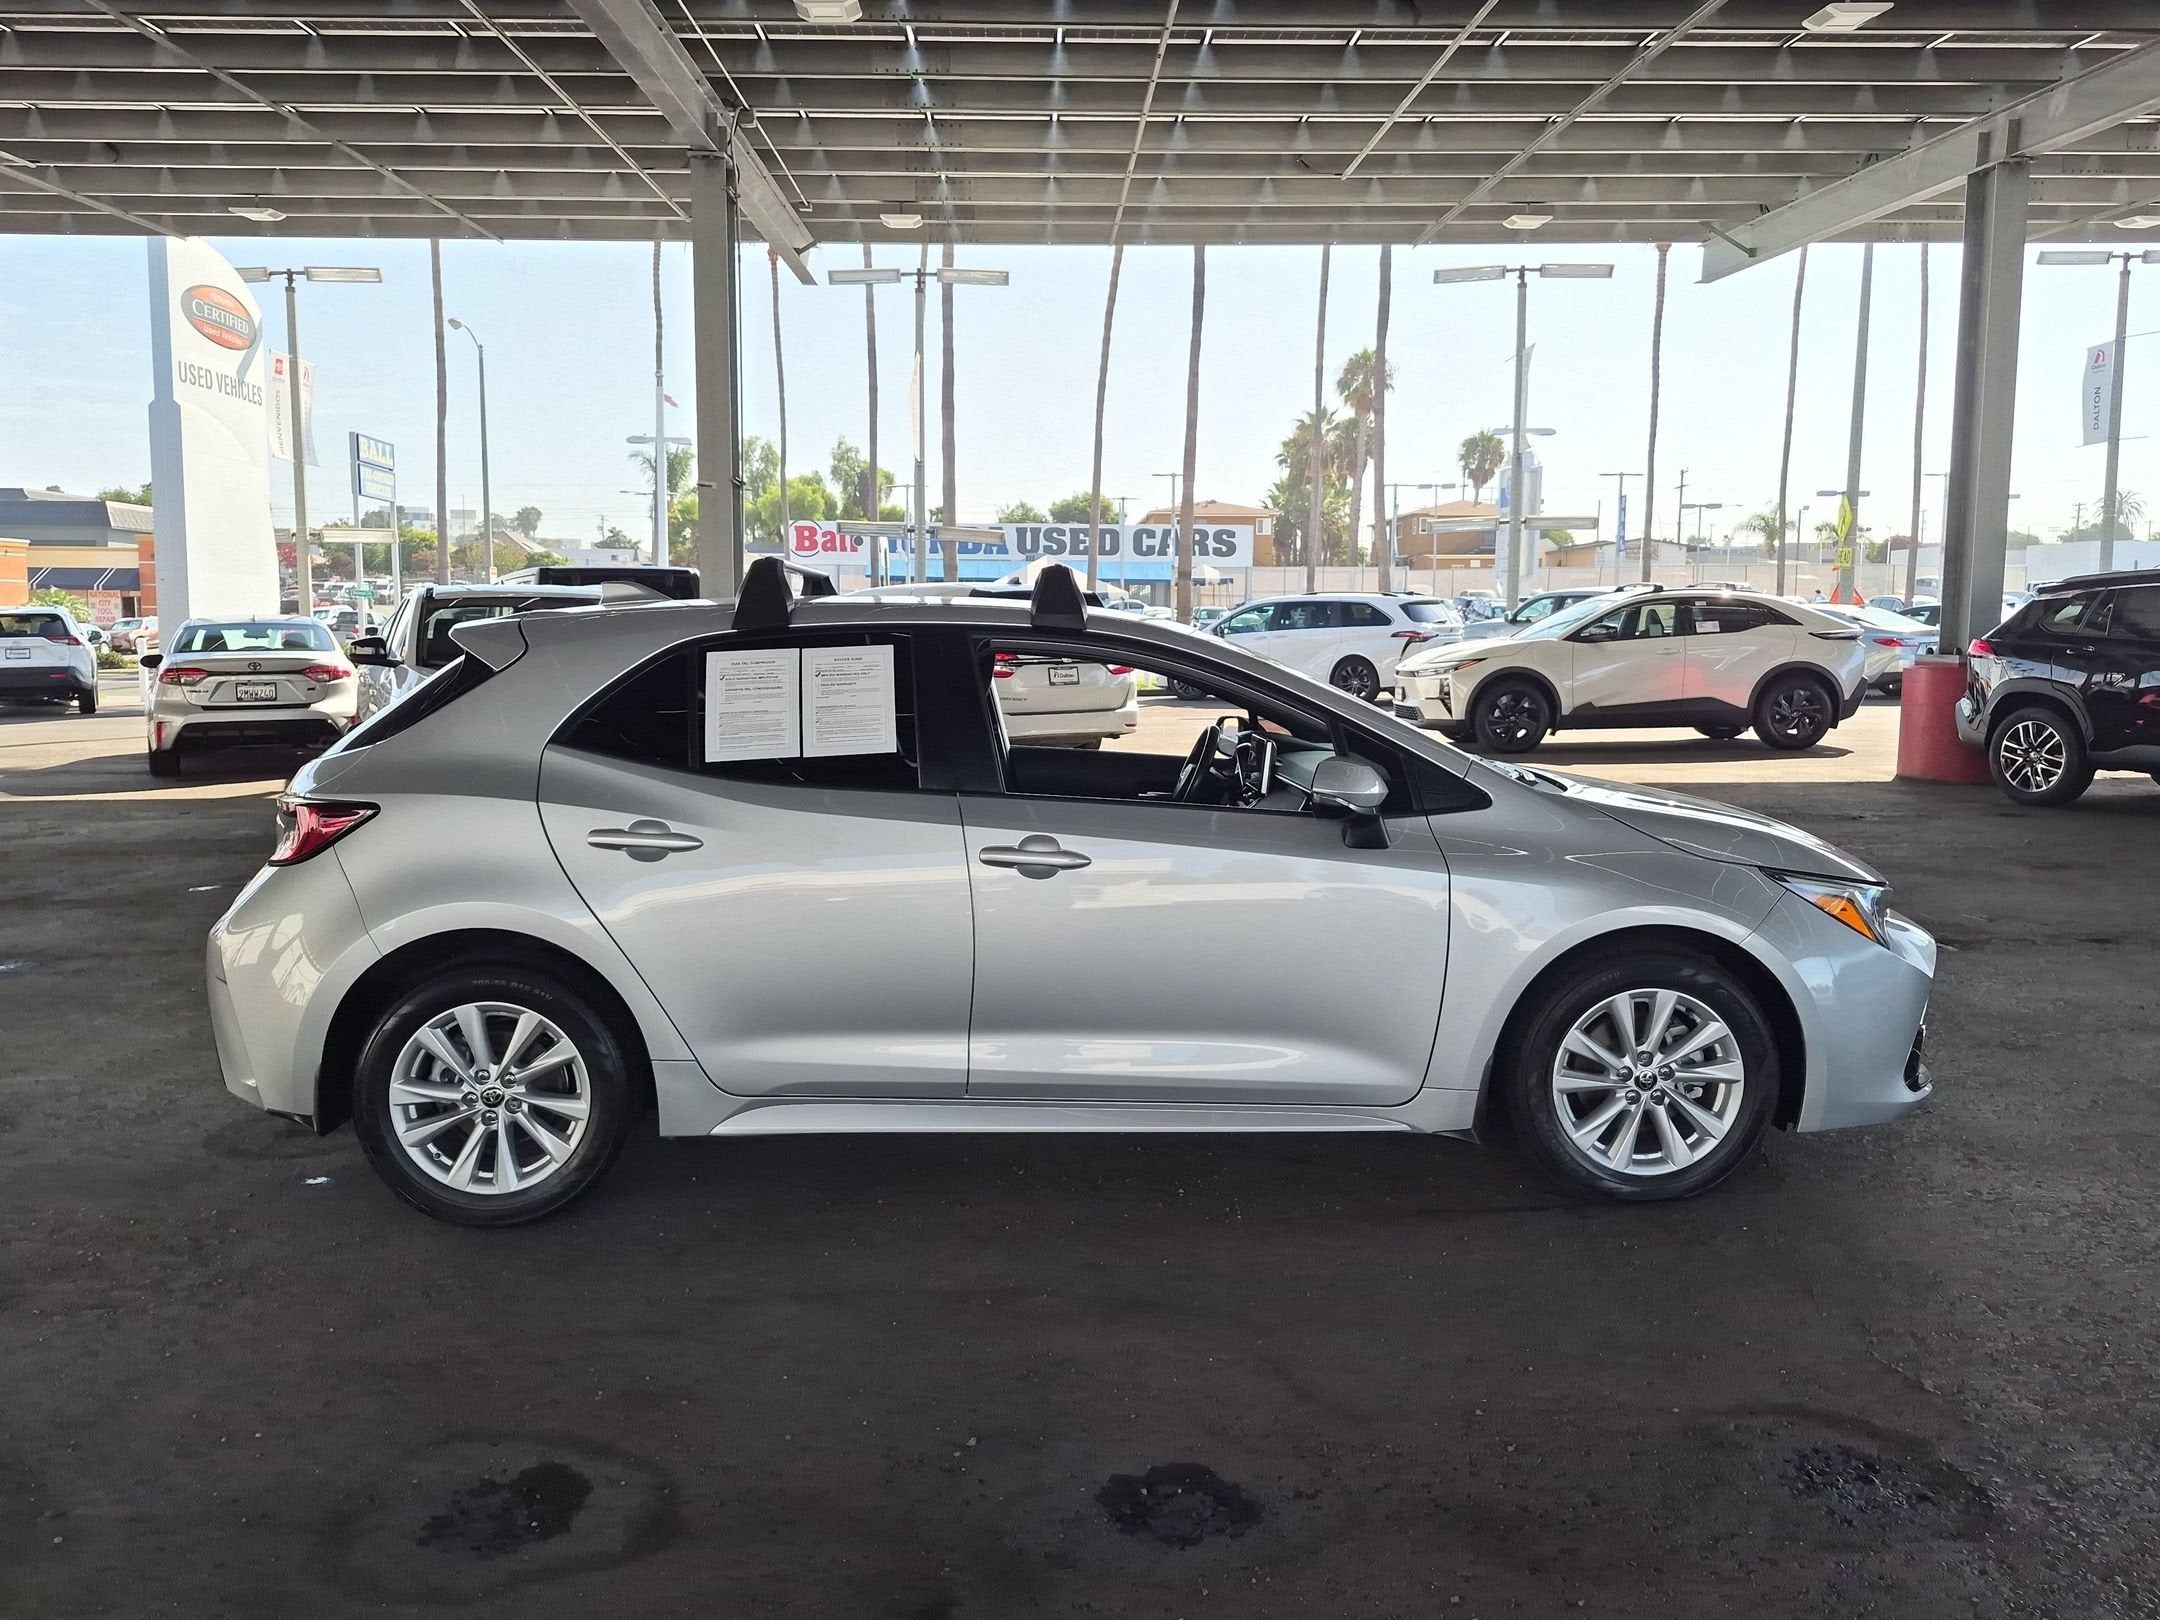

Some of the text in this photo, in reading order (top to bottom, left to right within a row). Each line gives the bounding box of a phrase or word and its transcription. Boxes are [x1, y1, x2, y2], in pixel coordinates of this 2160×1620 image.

[192, 299, 249, 333] CERTIFIED
[178, 361, 263, 406] USED VEHICLES
[2093, 386, 2102, 430] DALTON
[1016, 527, 1120, 556] USED
[1132, 528, 1237, 558] CARS
